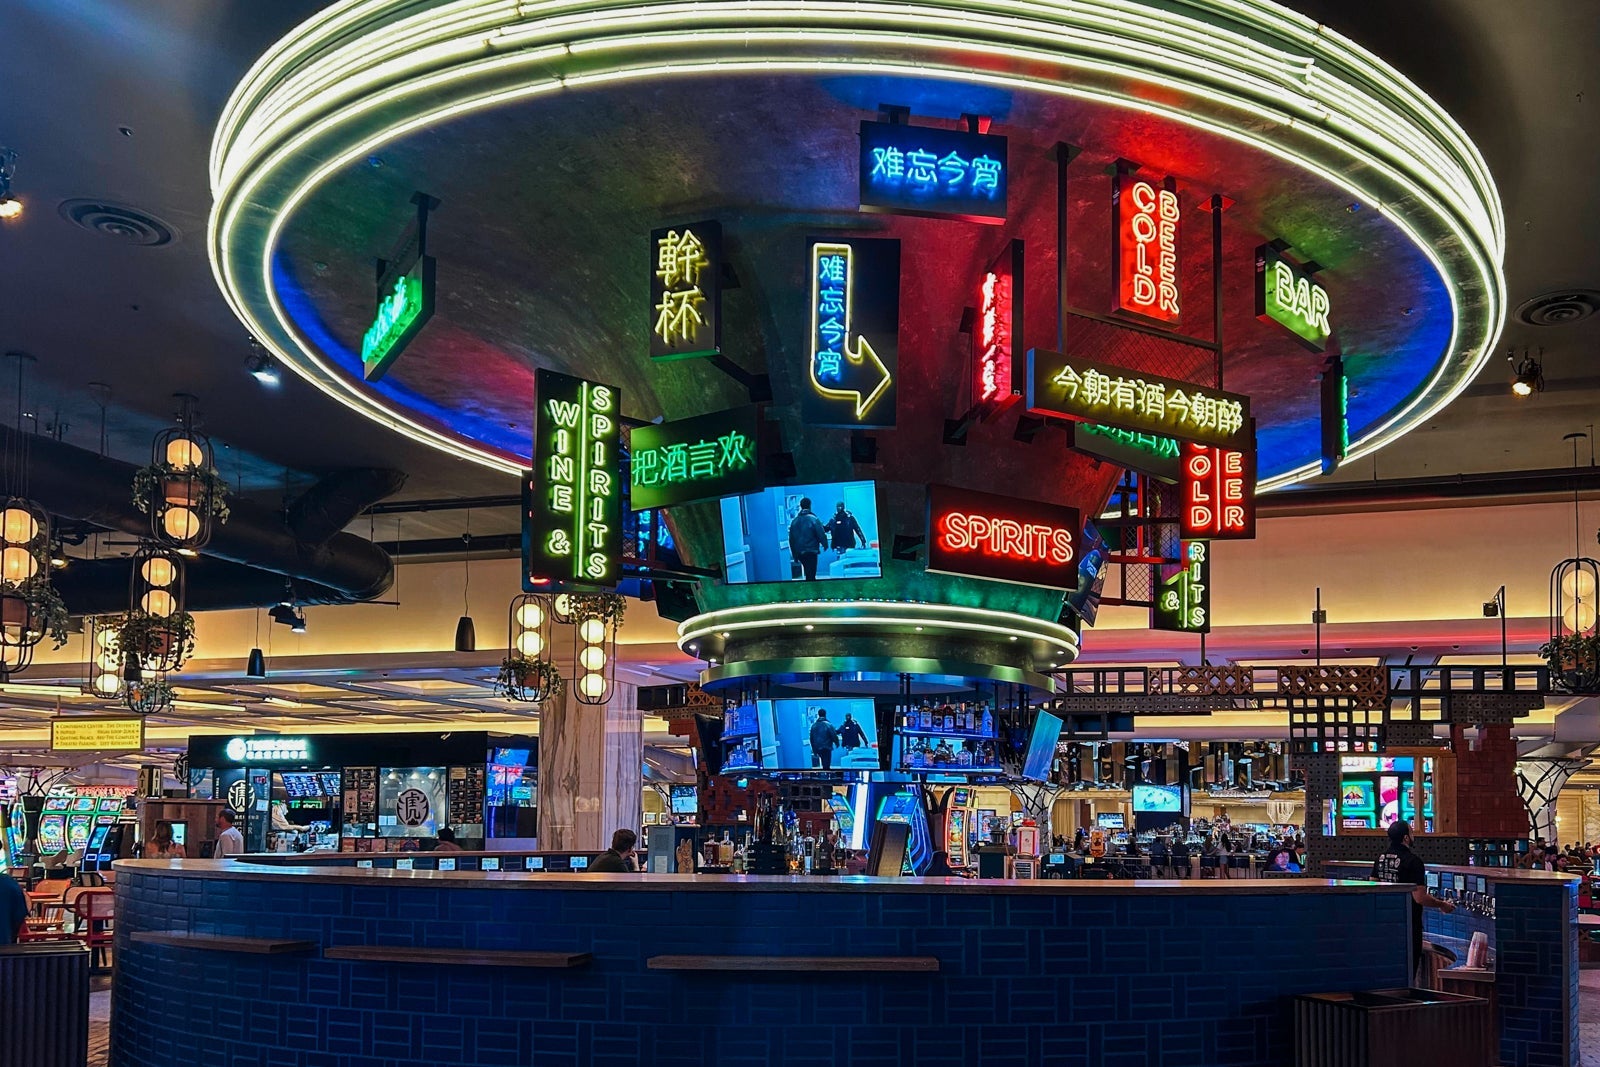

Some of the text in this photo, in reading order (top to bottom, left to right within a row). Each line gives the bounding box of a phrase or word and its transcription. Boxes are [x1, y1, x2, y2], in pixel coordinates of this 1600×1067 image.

[871, 145, 1002, 189] 难忘今宵
[1131, 180, 1157, 307] COLD
[1158, 189, 1181, 316] BEER
[816, 254, 847, 377] 难忘今宵
[1273, 259, 1332, 337] BAR
[1051, 363, 1244, 436] 今朝有酒今朝醉
[546, 398, 581, 556] WINE &
[585, 384, 614, 580] SPIRITS
[631, 429, 748, 488] 把酒言欢
[1223, 450, 1246, 529] EER
[943, 510, 1075, 565] SPIRITS
[139, 770, 147, 798] ATM
[152, 770, 160, 796] ATM
